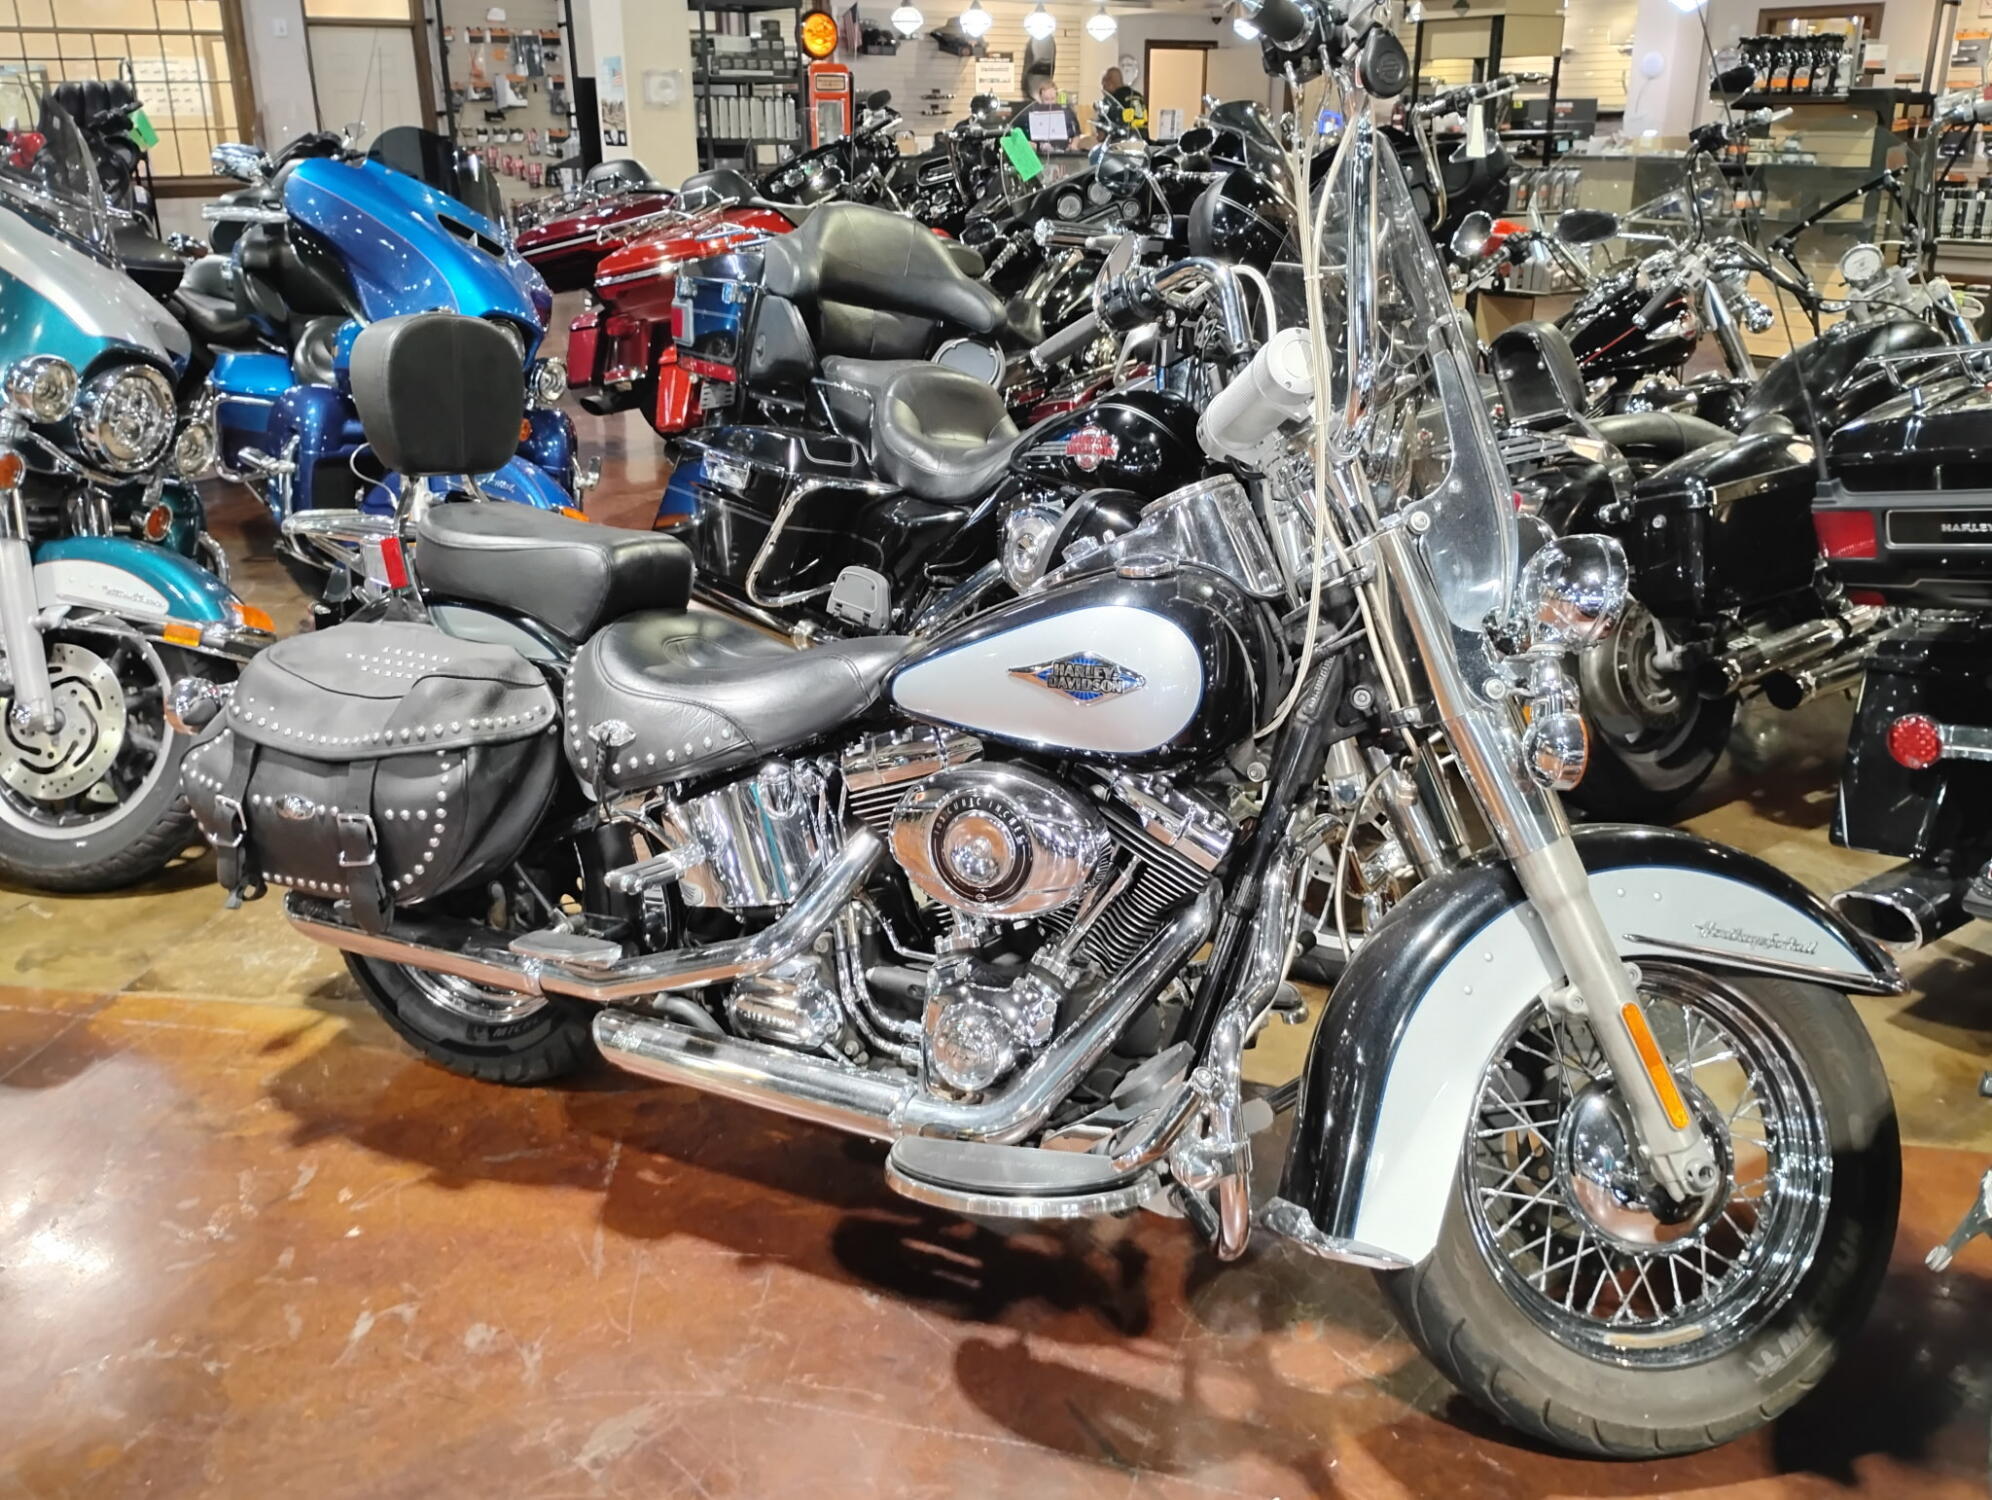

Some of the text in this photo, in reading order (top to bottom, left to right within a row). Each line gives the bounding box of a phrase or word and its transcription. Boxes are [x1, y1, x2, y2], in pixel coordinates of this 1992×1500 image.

[1047, 676, 1123, 694] DAVIDSON
[945, 796, 982, 815] CUBIC
[987, 799, 1027, 845] INCHES
